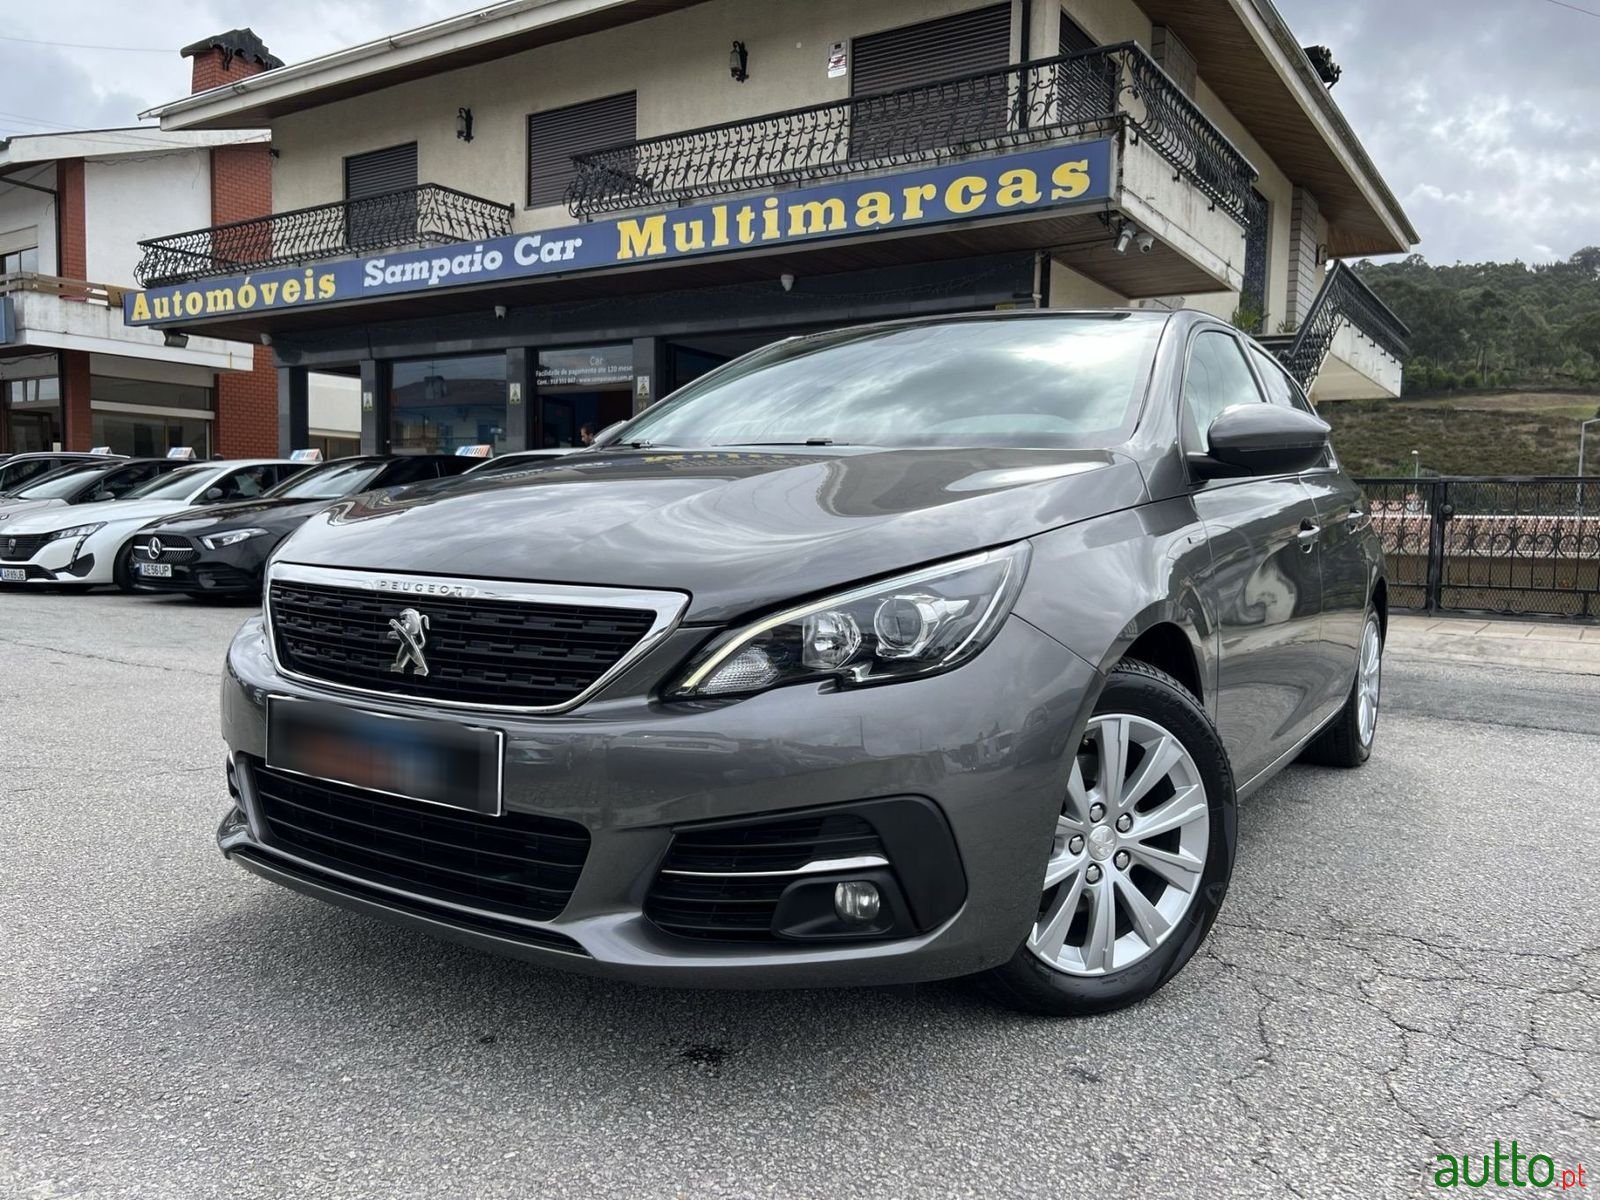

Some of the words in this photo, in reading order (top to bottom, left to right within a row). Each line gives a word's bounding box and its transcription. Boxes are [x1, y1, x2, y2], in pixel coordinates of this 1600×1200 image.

[131, 268, 336, 322] Automóveis
[363, 244, 503, 288] Sampaio
[513, 236, 584, 267] Car
[617, 159, 1092, 261] Multimarcas
[589, 356, 604, 366] Car
[380, 580, 463, 597] PEUGEOT
